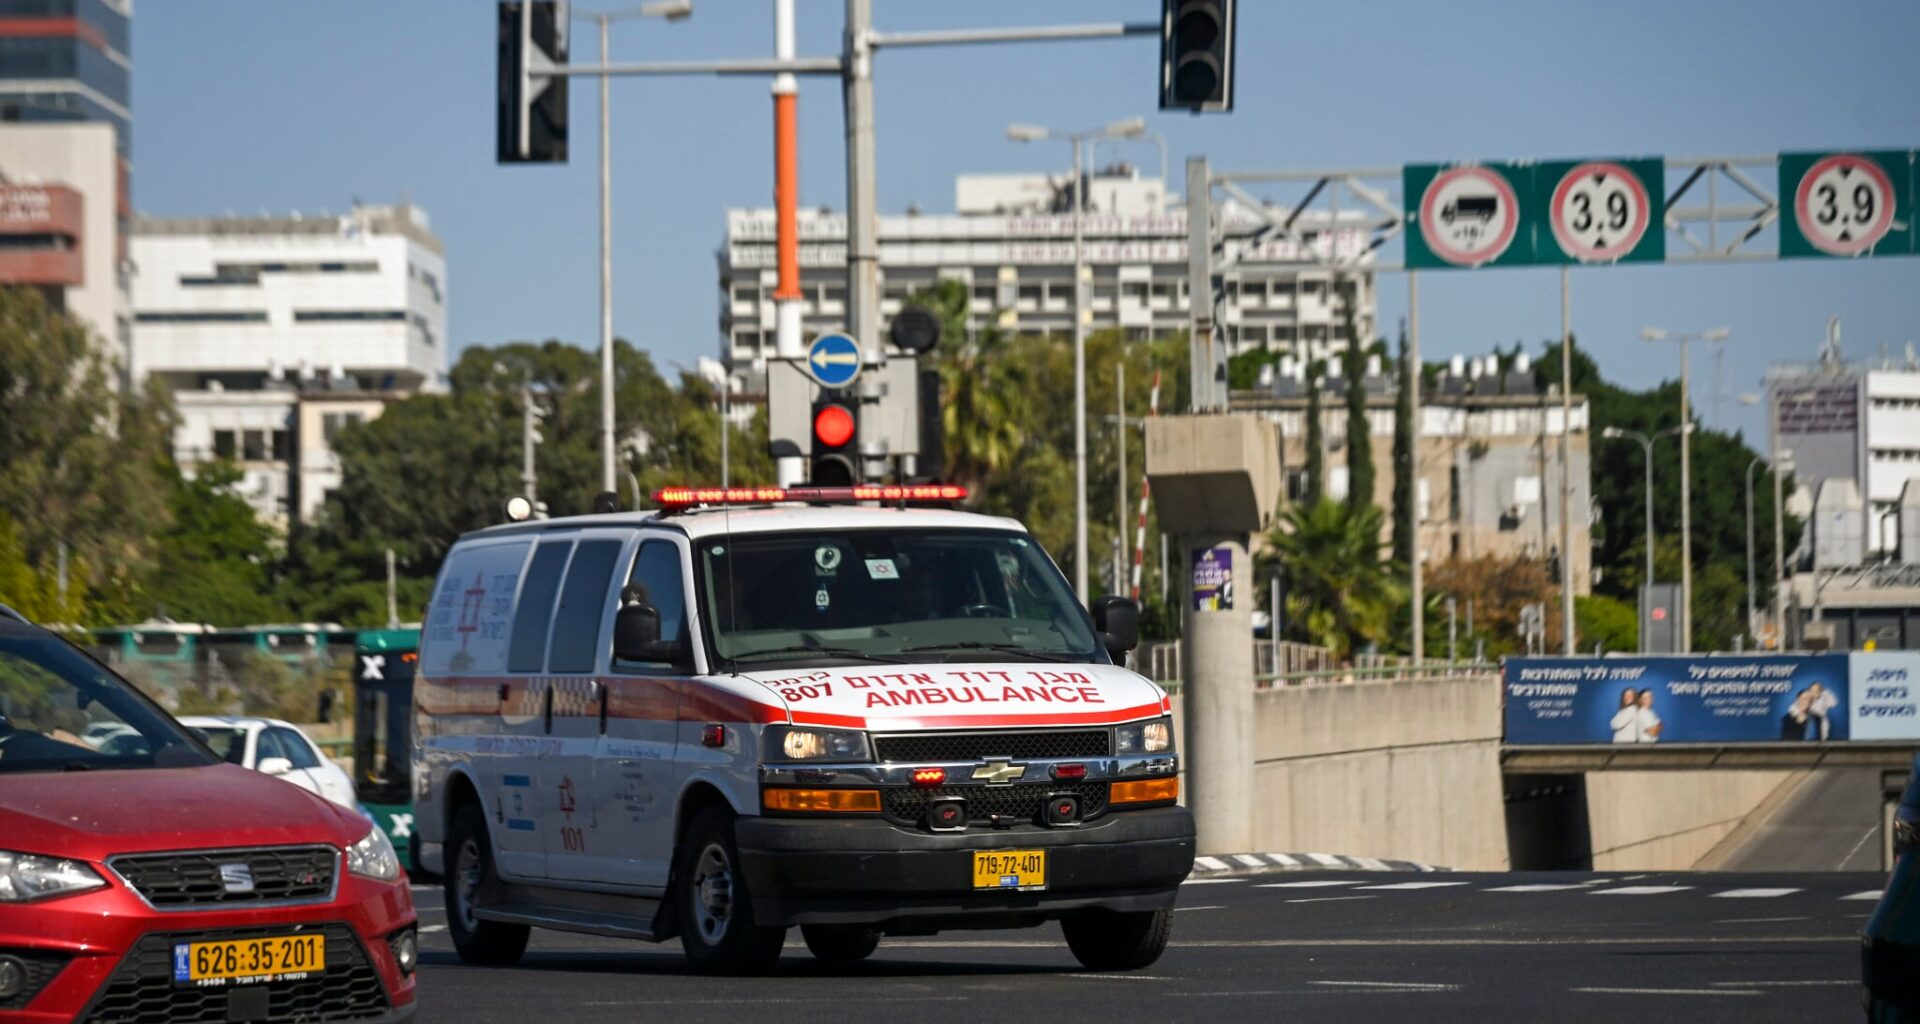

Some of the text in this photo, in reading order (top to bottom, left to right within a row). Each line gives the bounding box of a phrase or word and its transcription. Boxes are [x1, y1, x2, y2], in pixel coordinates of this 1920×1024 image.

[1572, 190, 1628, 232] 3.9
[1818, 184, 1875, 225] 3.9
[843, 671, 1091, 689] מגן דוד אדום
[780, 682, 832, 702] 807
[865, 687, 1105, 708] AMBULANCE
[560, 826, 584, 851] 101
